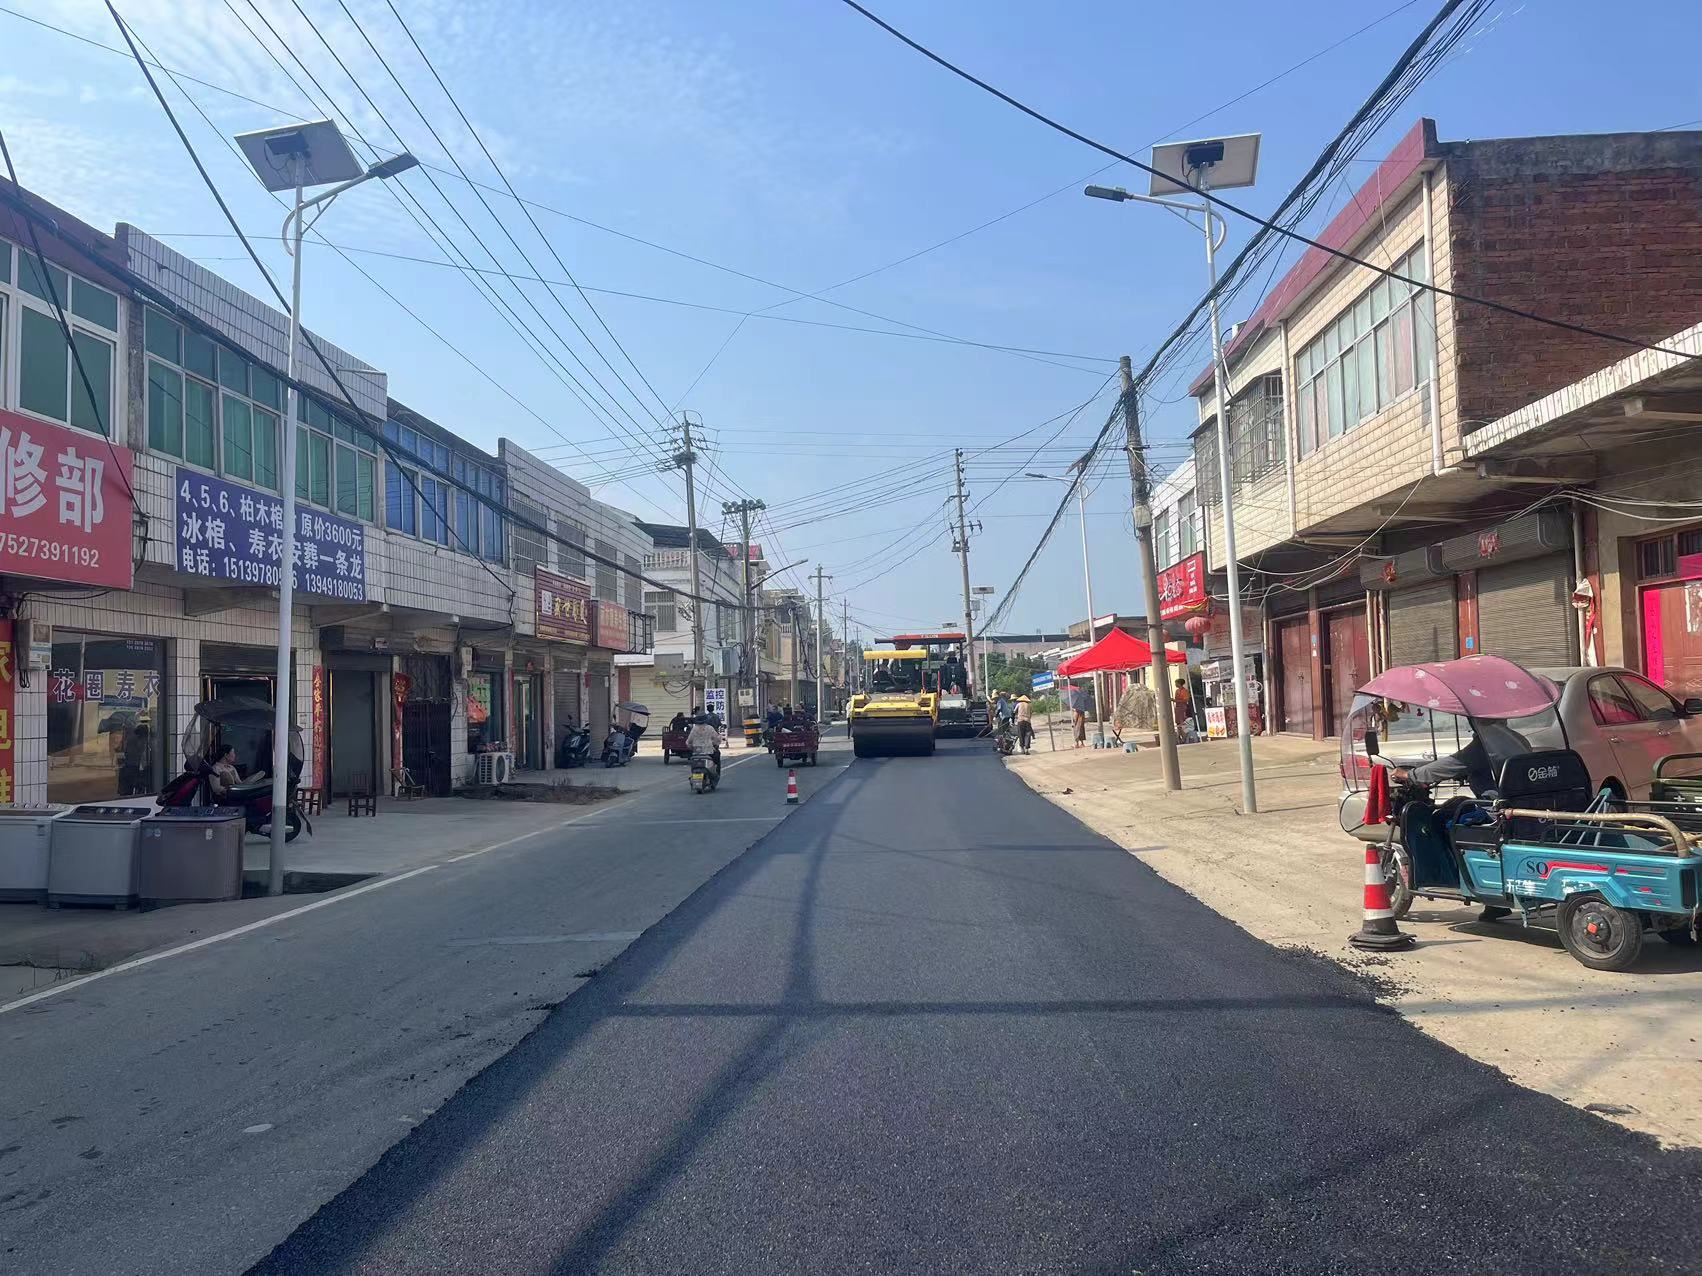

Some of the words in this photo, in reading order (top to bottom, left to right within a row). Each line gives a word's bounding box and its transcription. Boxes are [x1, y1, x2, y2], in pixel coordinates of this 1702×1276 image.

[305, 573, 364, 601] 13949180053
[53, 668, 161, 703] 花圈寿衣
